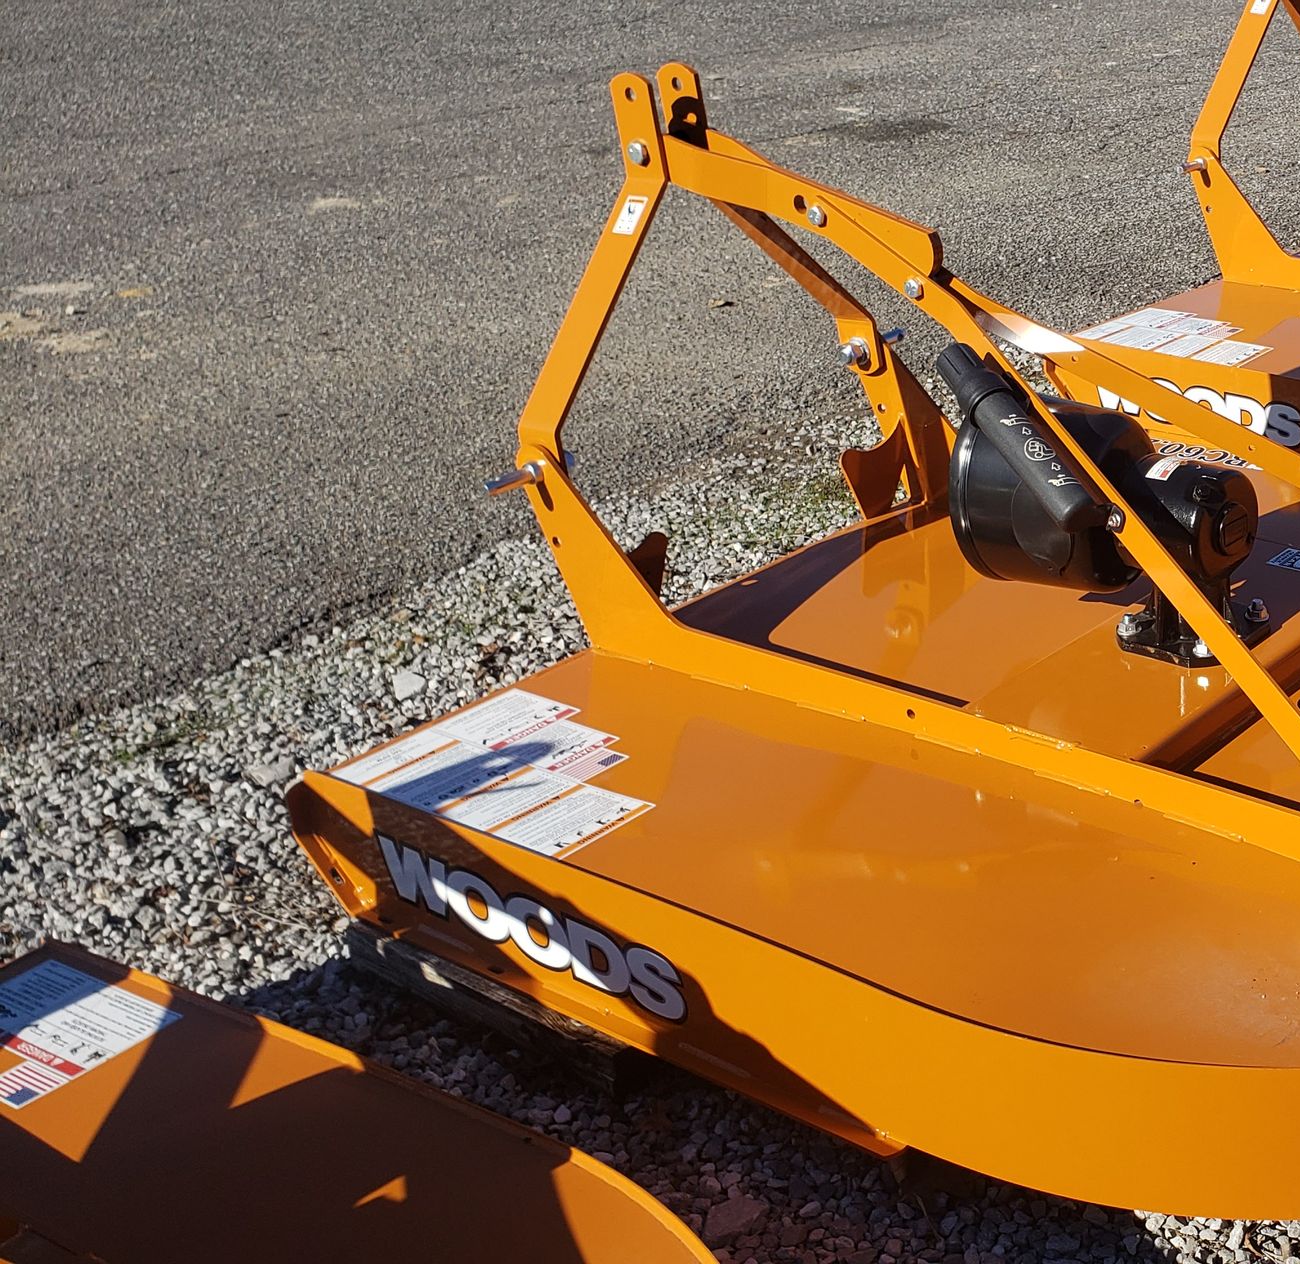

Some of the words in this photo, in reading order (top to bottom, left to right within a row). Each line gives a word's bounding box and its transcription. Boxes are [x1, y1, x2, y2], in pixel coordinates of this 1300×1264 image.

[505, 720, 548, 744] DANGER
[554, 745, 594, 769] DANGER
[511, 799, 553, 822] WARNING
[576, 821, 616, 846] WARNING
[373, 827, 688, 1024] WOODS
